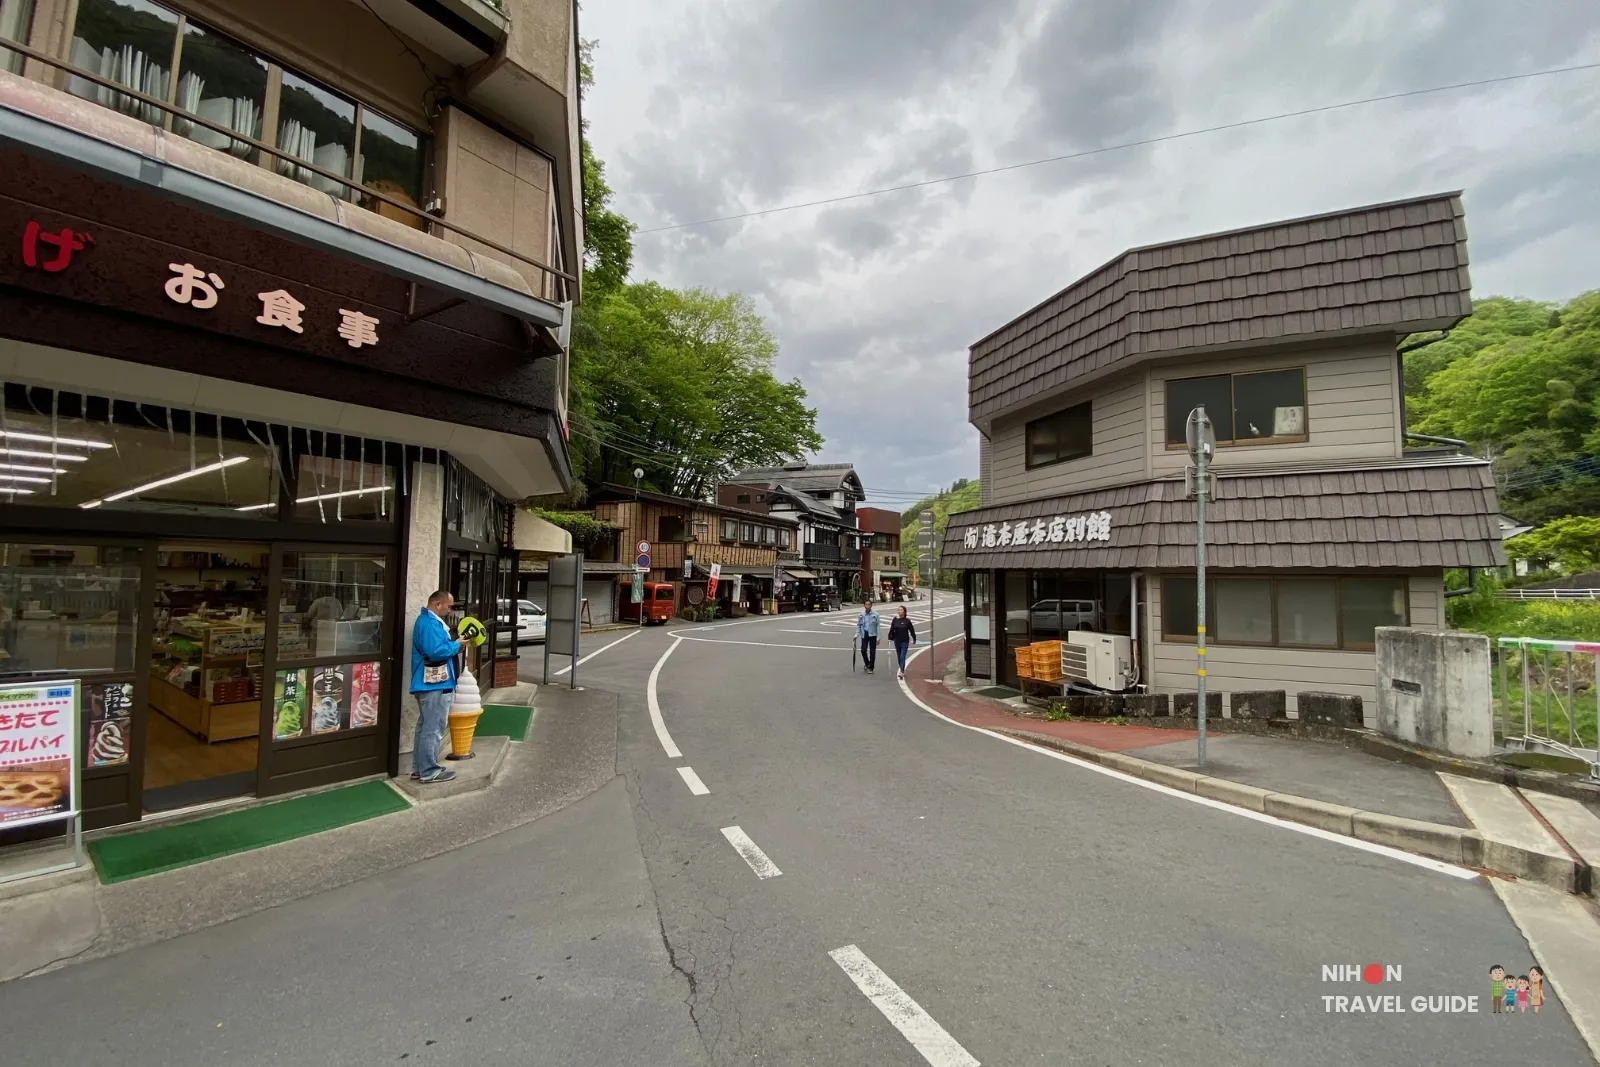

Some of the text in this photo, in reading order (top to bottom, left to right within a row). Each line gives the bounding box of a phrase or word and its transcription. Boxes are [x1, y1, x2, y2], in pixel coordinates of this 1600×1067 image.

[22, 220, 94, 272] げ
[164, 262, 380, 348] お食事
[285, 673, 297, 696] 抹茶
[324, 668, 334, 692] 黒ごま
